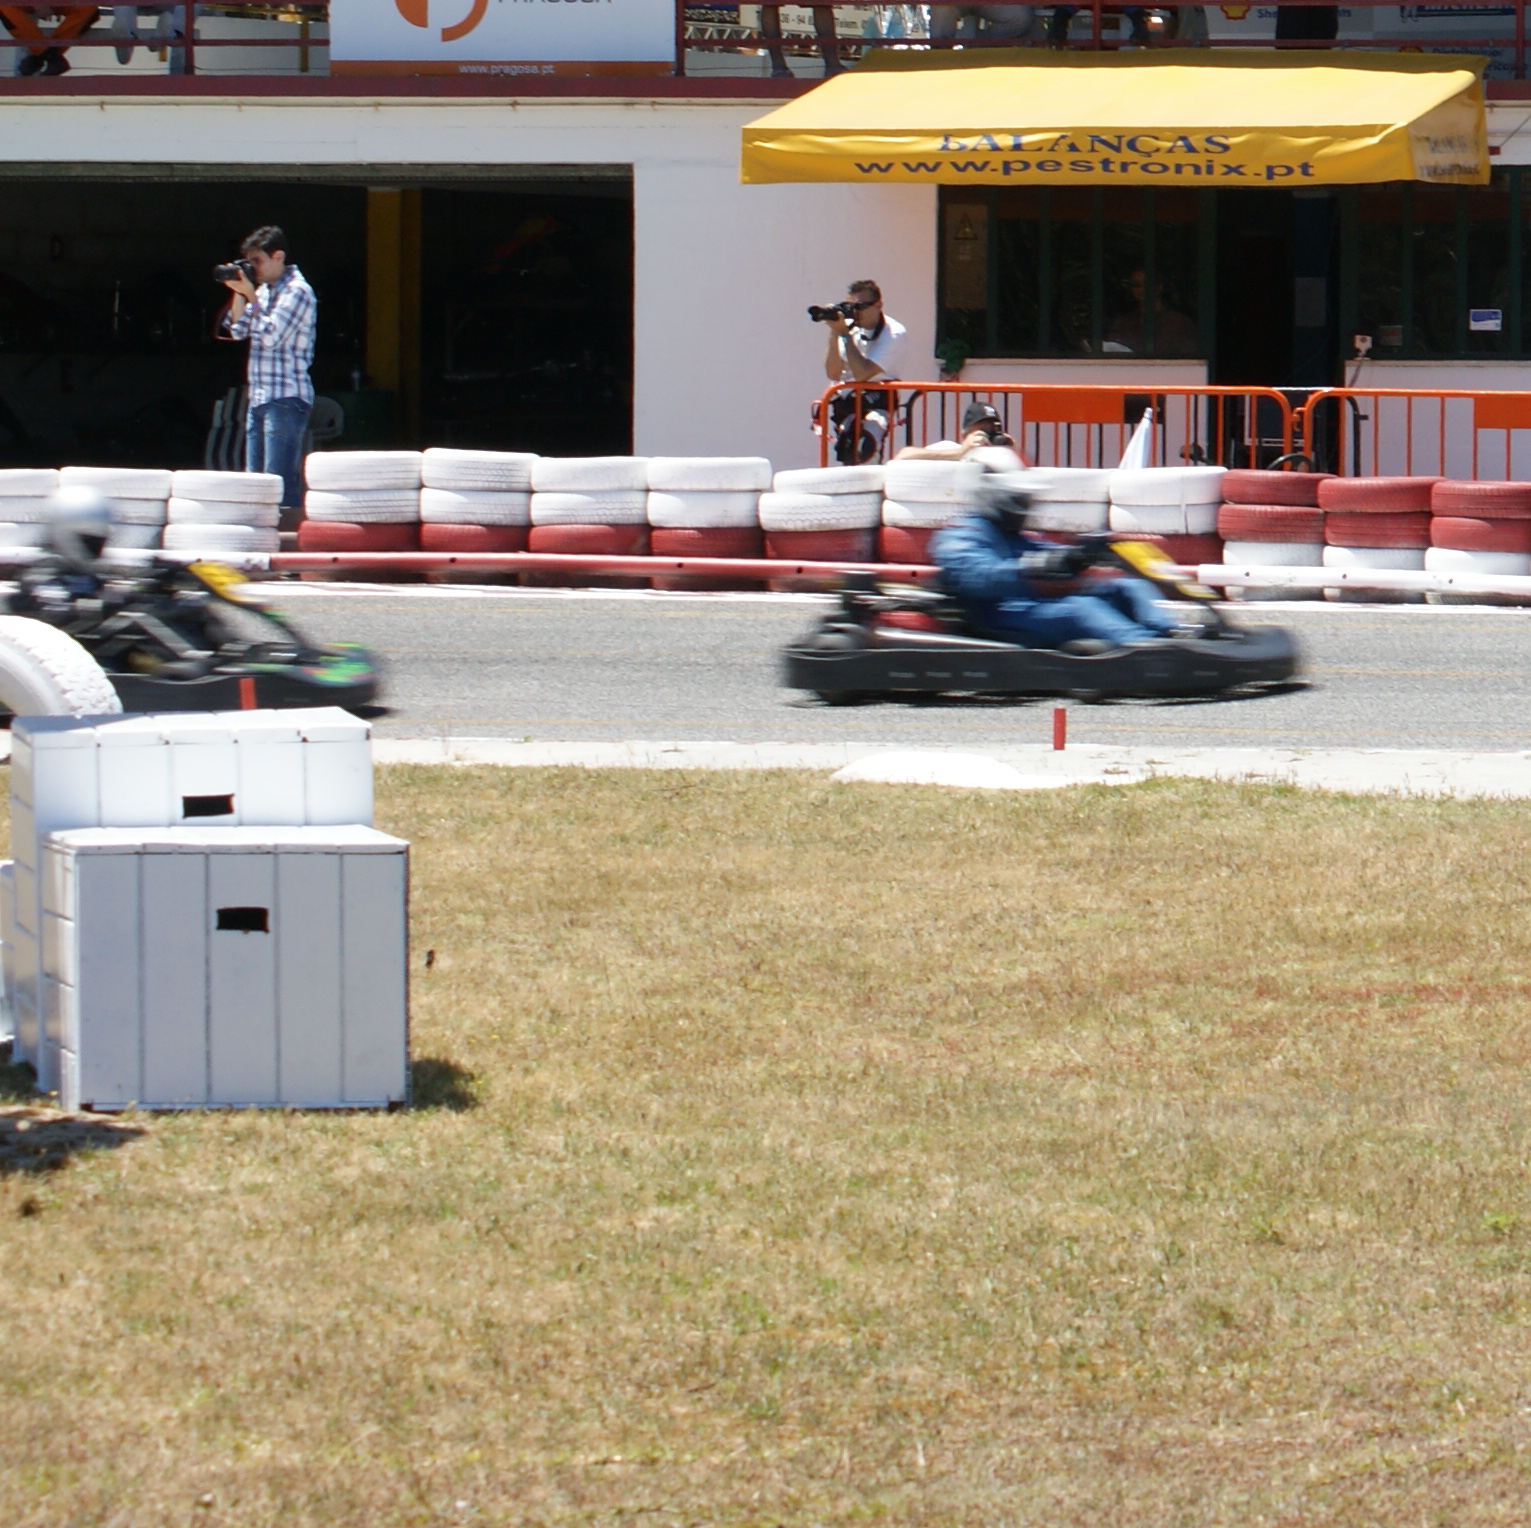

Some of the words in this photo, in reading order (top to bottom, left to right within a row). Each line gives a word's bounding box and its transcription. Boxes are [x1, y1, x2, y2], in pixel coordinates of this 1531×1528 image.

[458, 64, 555, 76] www.pragosa.pt
[937, 133, 1231, 158] BALANÇAS
[854, 158, 1316, 181] www.pestronix.pt
